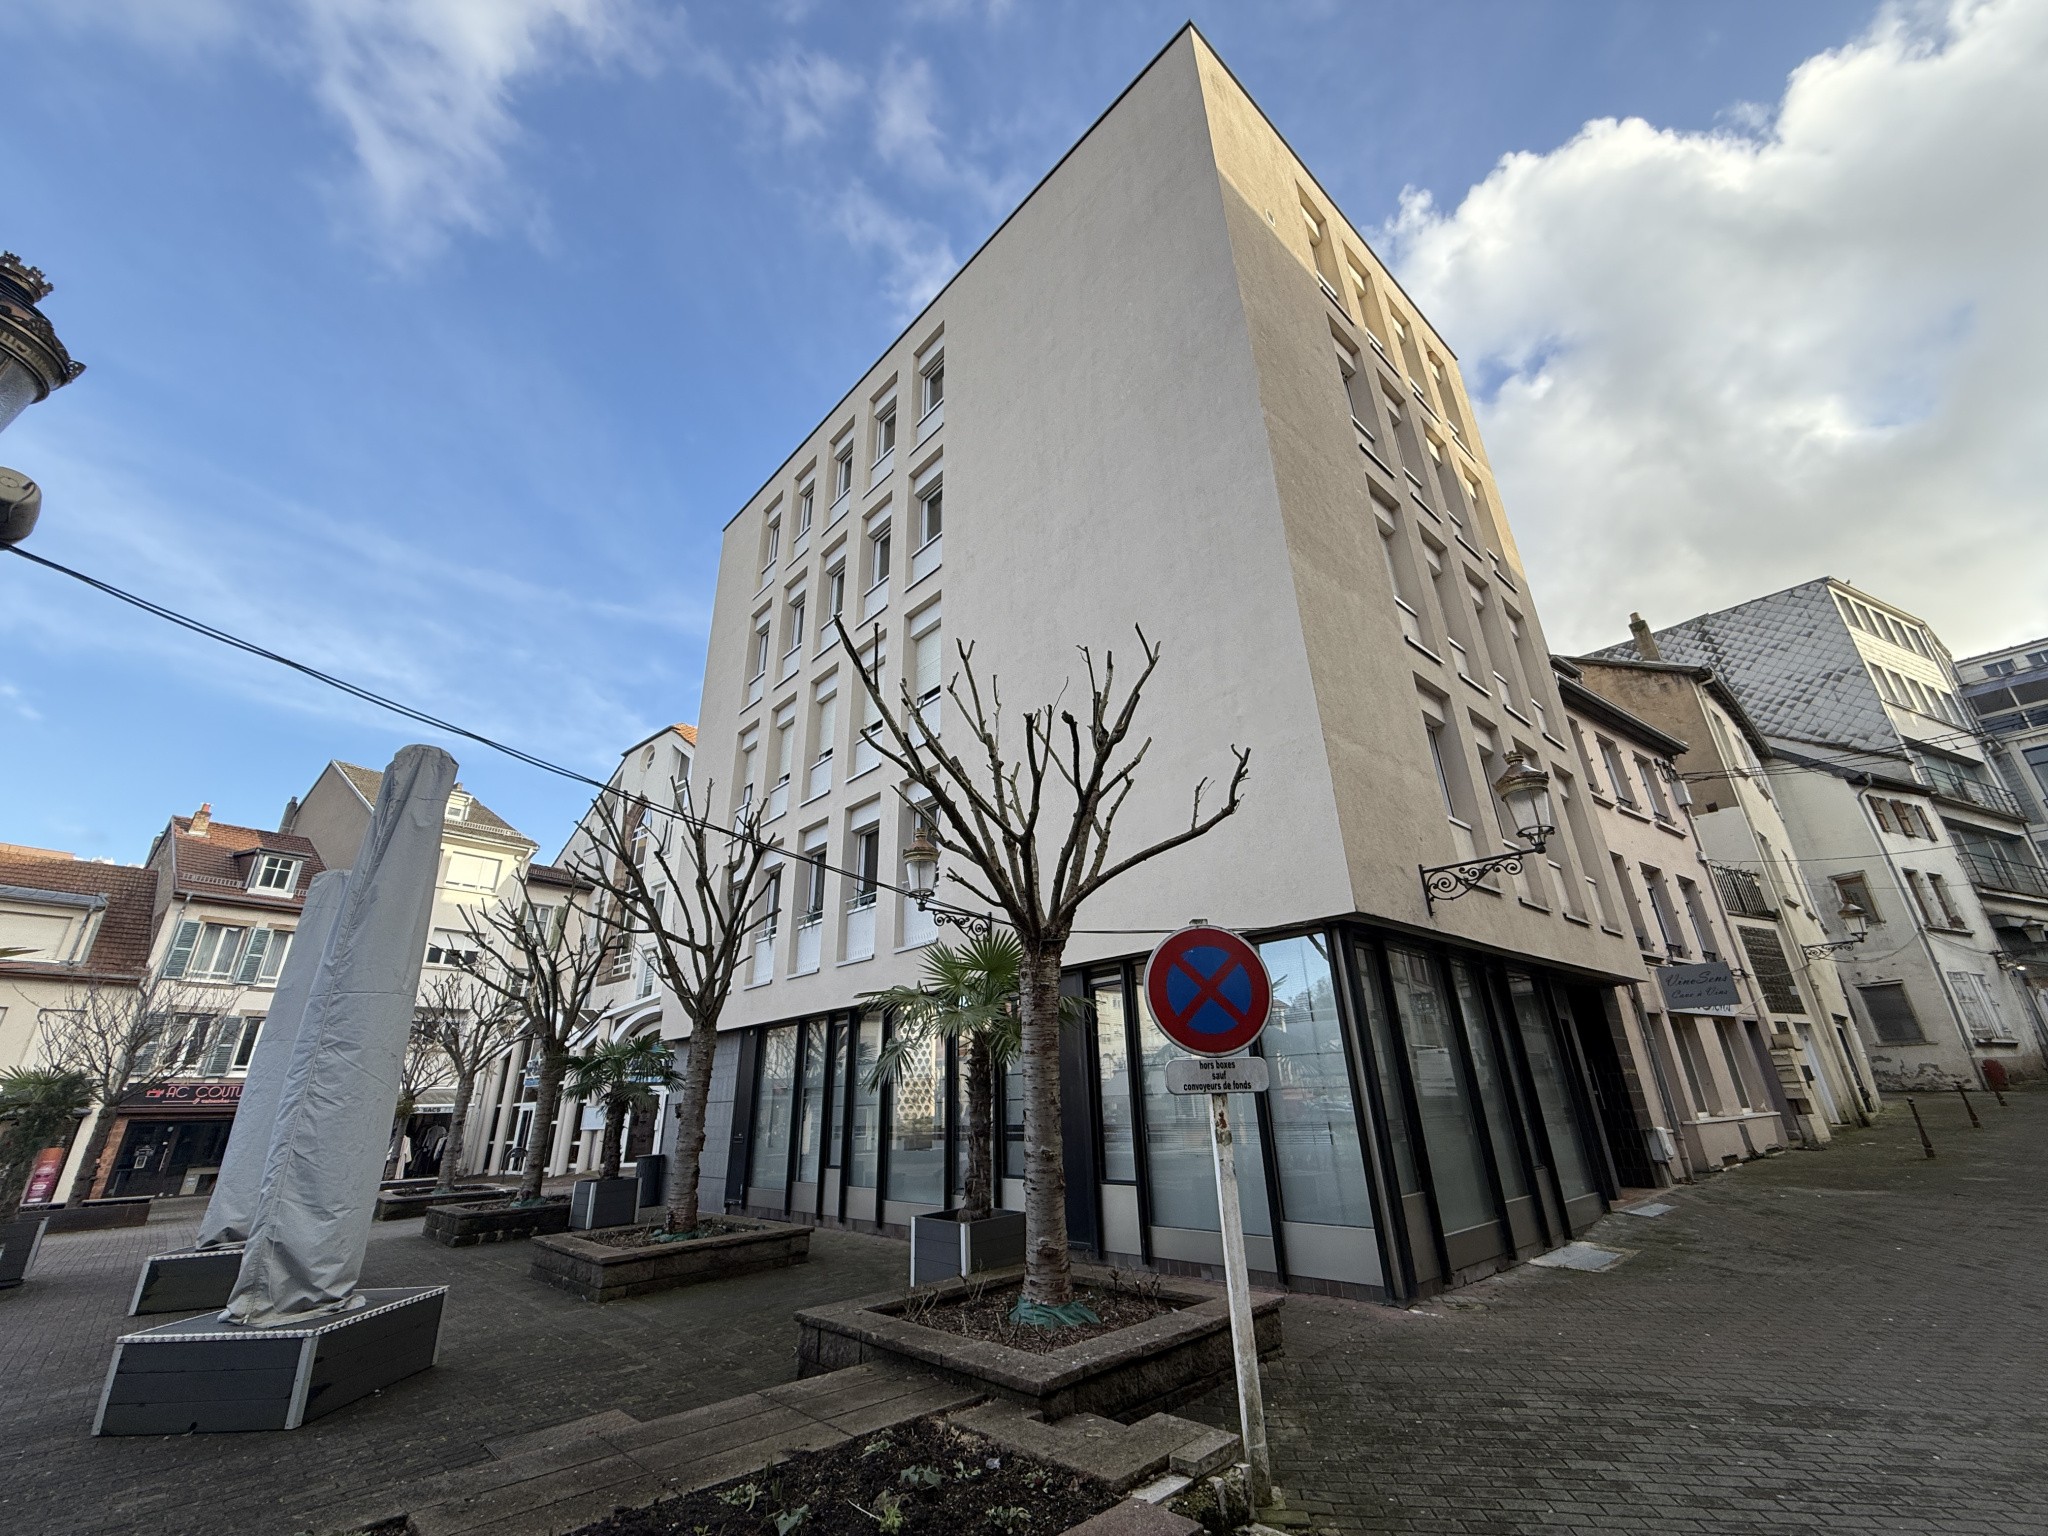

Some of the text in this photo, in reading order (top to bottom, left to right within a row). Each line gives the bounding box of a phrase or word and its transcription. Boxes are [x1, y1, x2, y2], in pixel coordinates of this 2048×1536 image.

[1705, 987, 1728, 996] Vins
[1199, 1060, 1236, 1070] hors boxes
[1212, 1071, 1226, 1080] sauf
[1183, 1080, 1252, 1092] convoyeurs de fonds
[166, 1086, 189, 1098] AC
